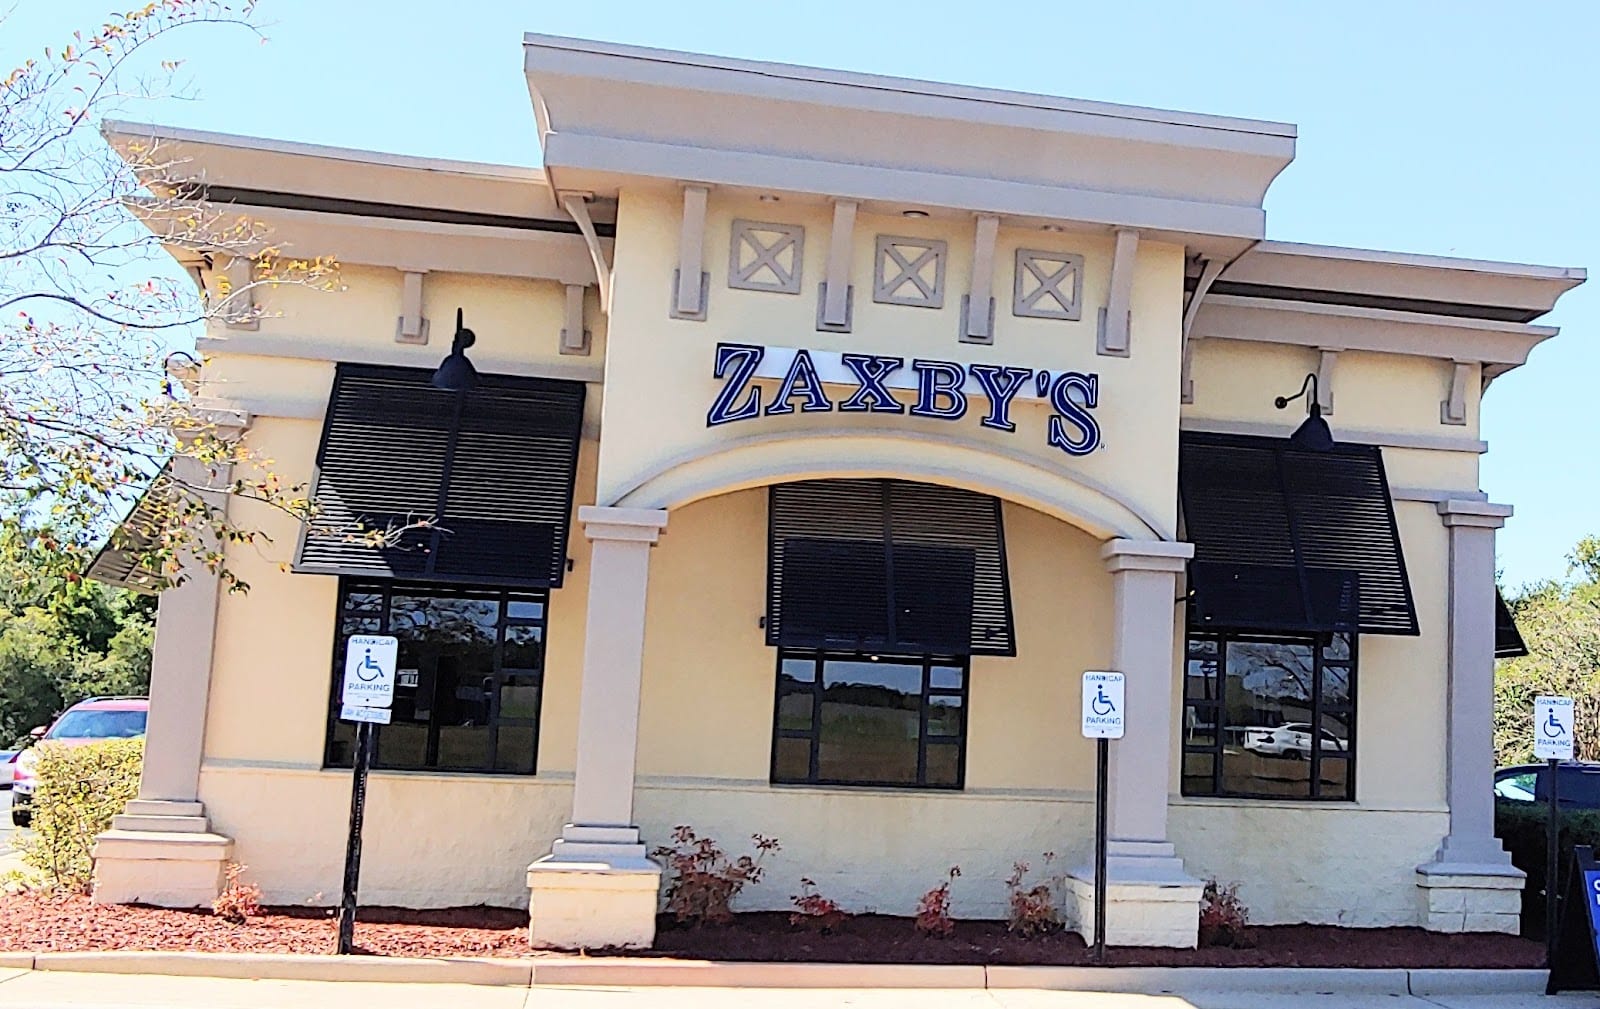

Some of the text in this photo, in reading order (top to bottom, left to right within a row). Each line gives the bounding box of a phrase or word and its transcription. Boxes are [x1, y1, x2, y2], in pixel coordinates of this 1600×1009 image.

[706, 342, 1101, 456] ZAXBY'S
[348, 682, 390, 691] PARKING
[1086, 716, 1121, 725] PARKING
